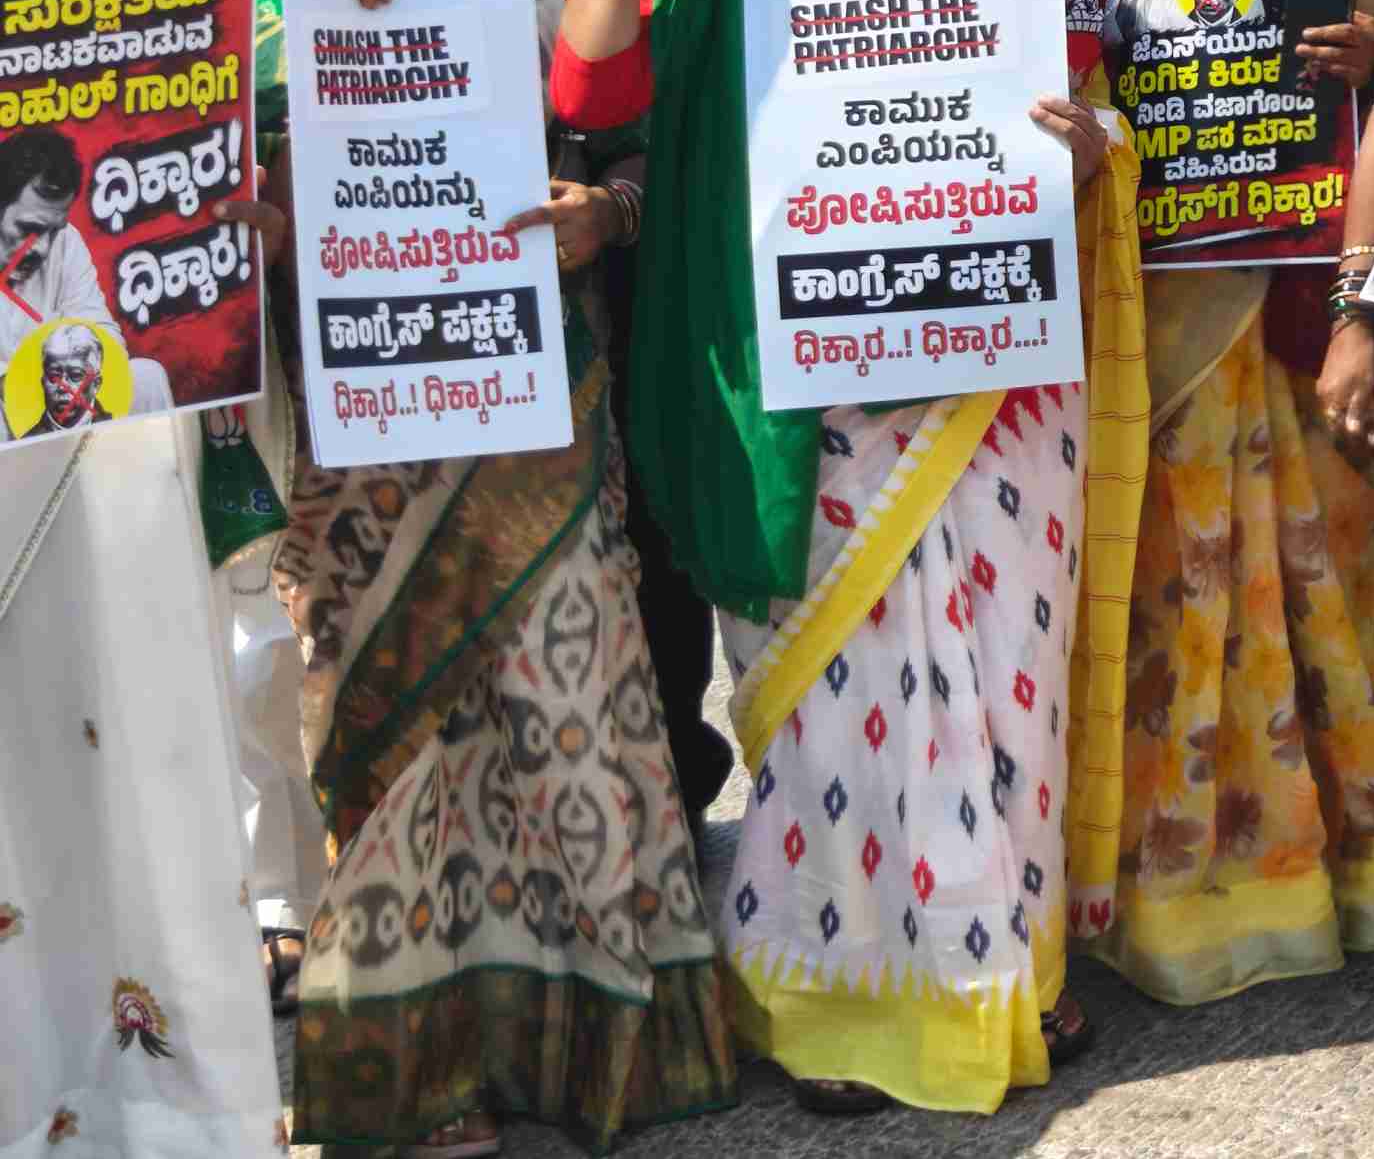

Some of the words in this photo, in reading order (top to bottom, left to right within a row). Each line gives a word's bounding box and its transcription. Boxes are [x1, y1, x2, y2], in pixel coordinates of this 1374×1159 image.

[313, 27, 382, 66] SMASH
[387, 25, 449, 63] THE
[793, 24, 1000, 74] PATRIARCHY
[124, 54, 239, 115] ಗಾಂಧಿಗೆ
[317, 61, 471, 105] PATRIARCHY
[843, 89, 972, 127] ಕಾಮುಕ
[347, 130, 447, 167] ಕಾಮುಕ
[1137, 125, 1191, 161] MP
[91, 116, 243, 232] ಧಿಕ್ಕಾರ!
[786, 176, 1039, 235] ಪೋಷಿಸುತ್ತಿರುವ
[790, 253, 941, 308] ಕಾಂಗ್ರೆಸ್
[950, 244, 1043, 304] ಪಕ್ಷಕ್ಕೆ
[327, 302, 434, 359] ಕಾಂಗ್ರೆಸ್
